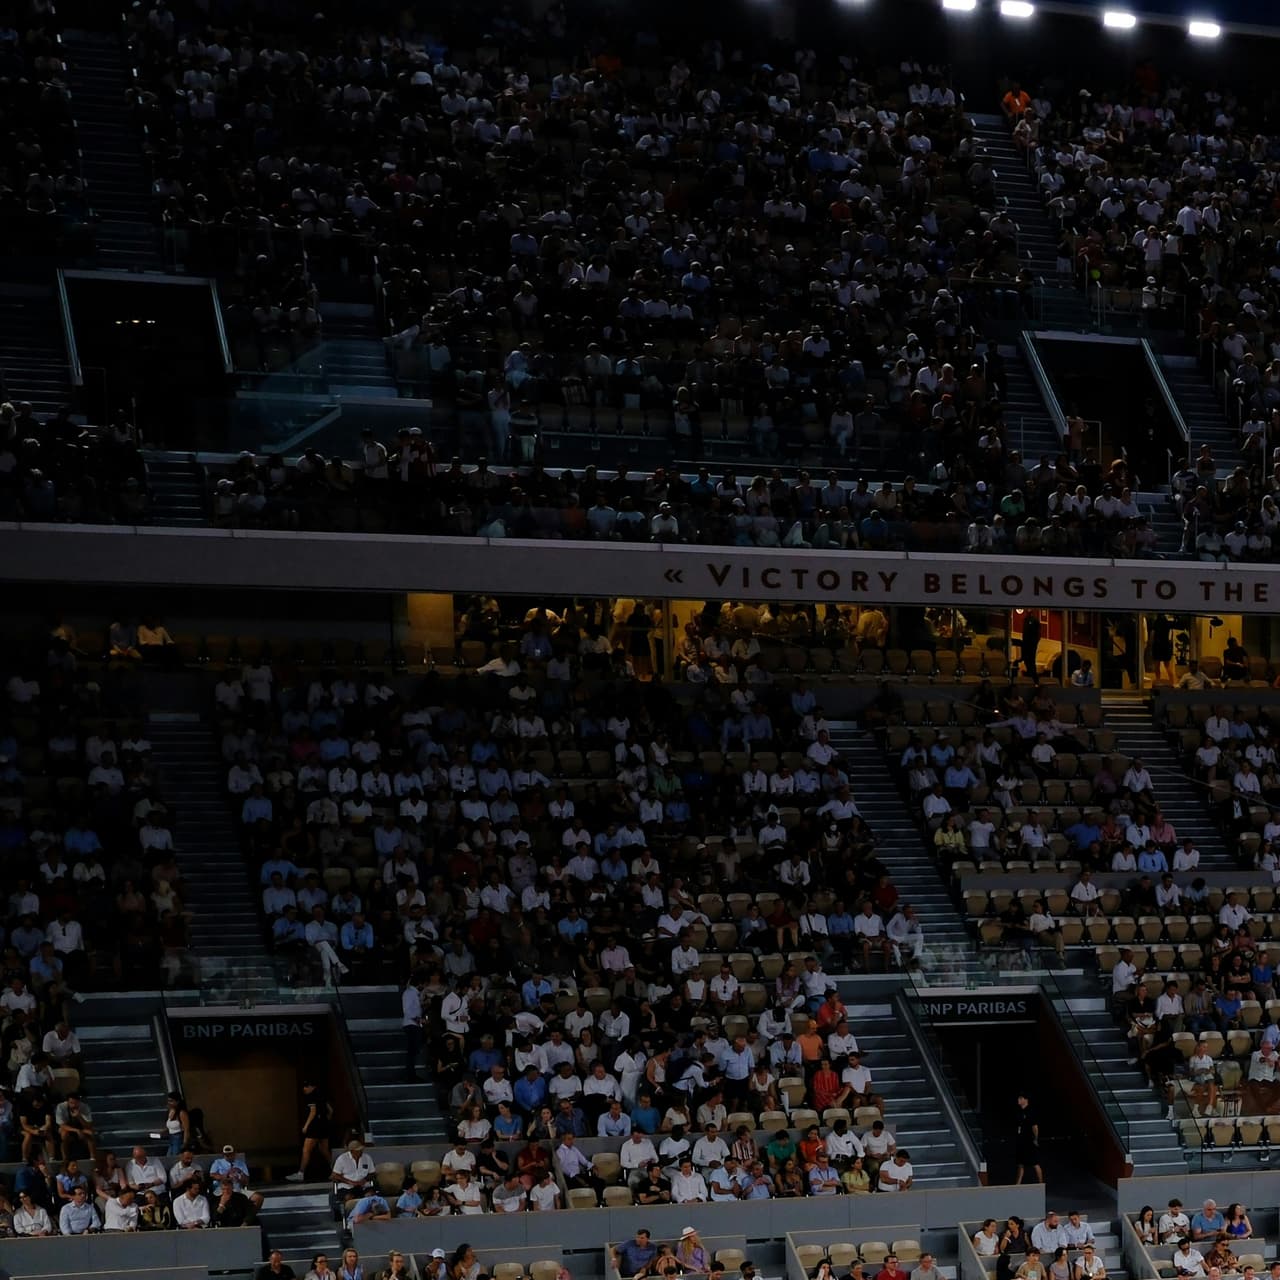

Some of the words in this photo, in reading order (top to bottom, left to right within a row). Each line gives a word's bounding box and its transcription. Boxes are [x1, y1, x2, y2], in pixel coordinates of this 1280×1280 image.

[706, 563, 898, 593] VICTORY
[924, 572, 1108, 599] BELONGS
[1131, 578, 1178, 600] TO
[1199, 581, 1269, 603] THE
[957, 1001, 1027, 1015] PARIBAS
[183, 1023, 225, 1039] BNP
[229, 1022, 314, 1038] PARIBAS
